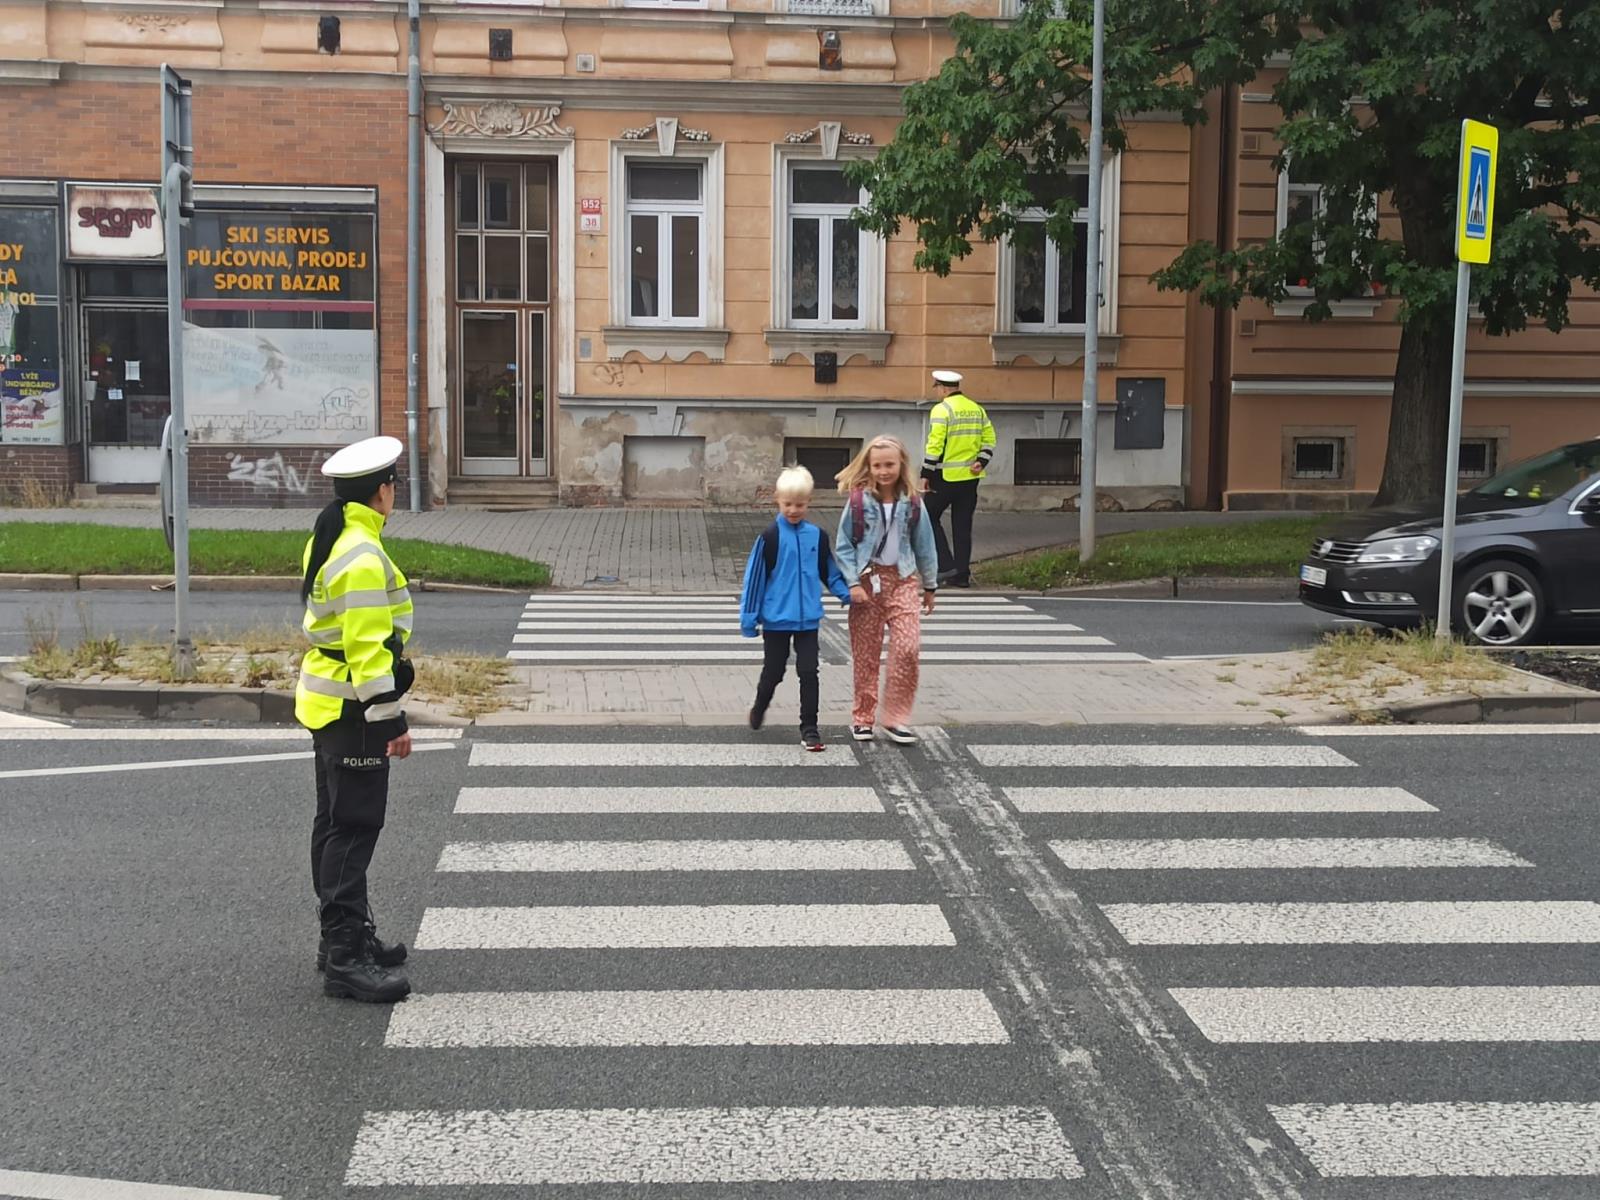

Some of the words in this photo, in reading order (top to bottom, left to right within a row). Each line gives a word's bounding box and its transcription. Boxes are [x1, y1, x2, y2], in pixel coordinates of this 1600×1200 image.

[582, 200, 600, 208] 952
[79, 207, 156, 228] SPORT
[585, 218, 597, 226] 38
[227, 226, 258, 244] SKI
[265, 227, 330, 245] SERVIS
[297, 251, 367, 268] PRODEJ
[214, 274, 275, 290] SPORT
[281, 275, 341, 291] BAZAR
[343, 757, 382, 767] POLICIE
